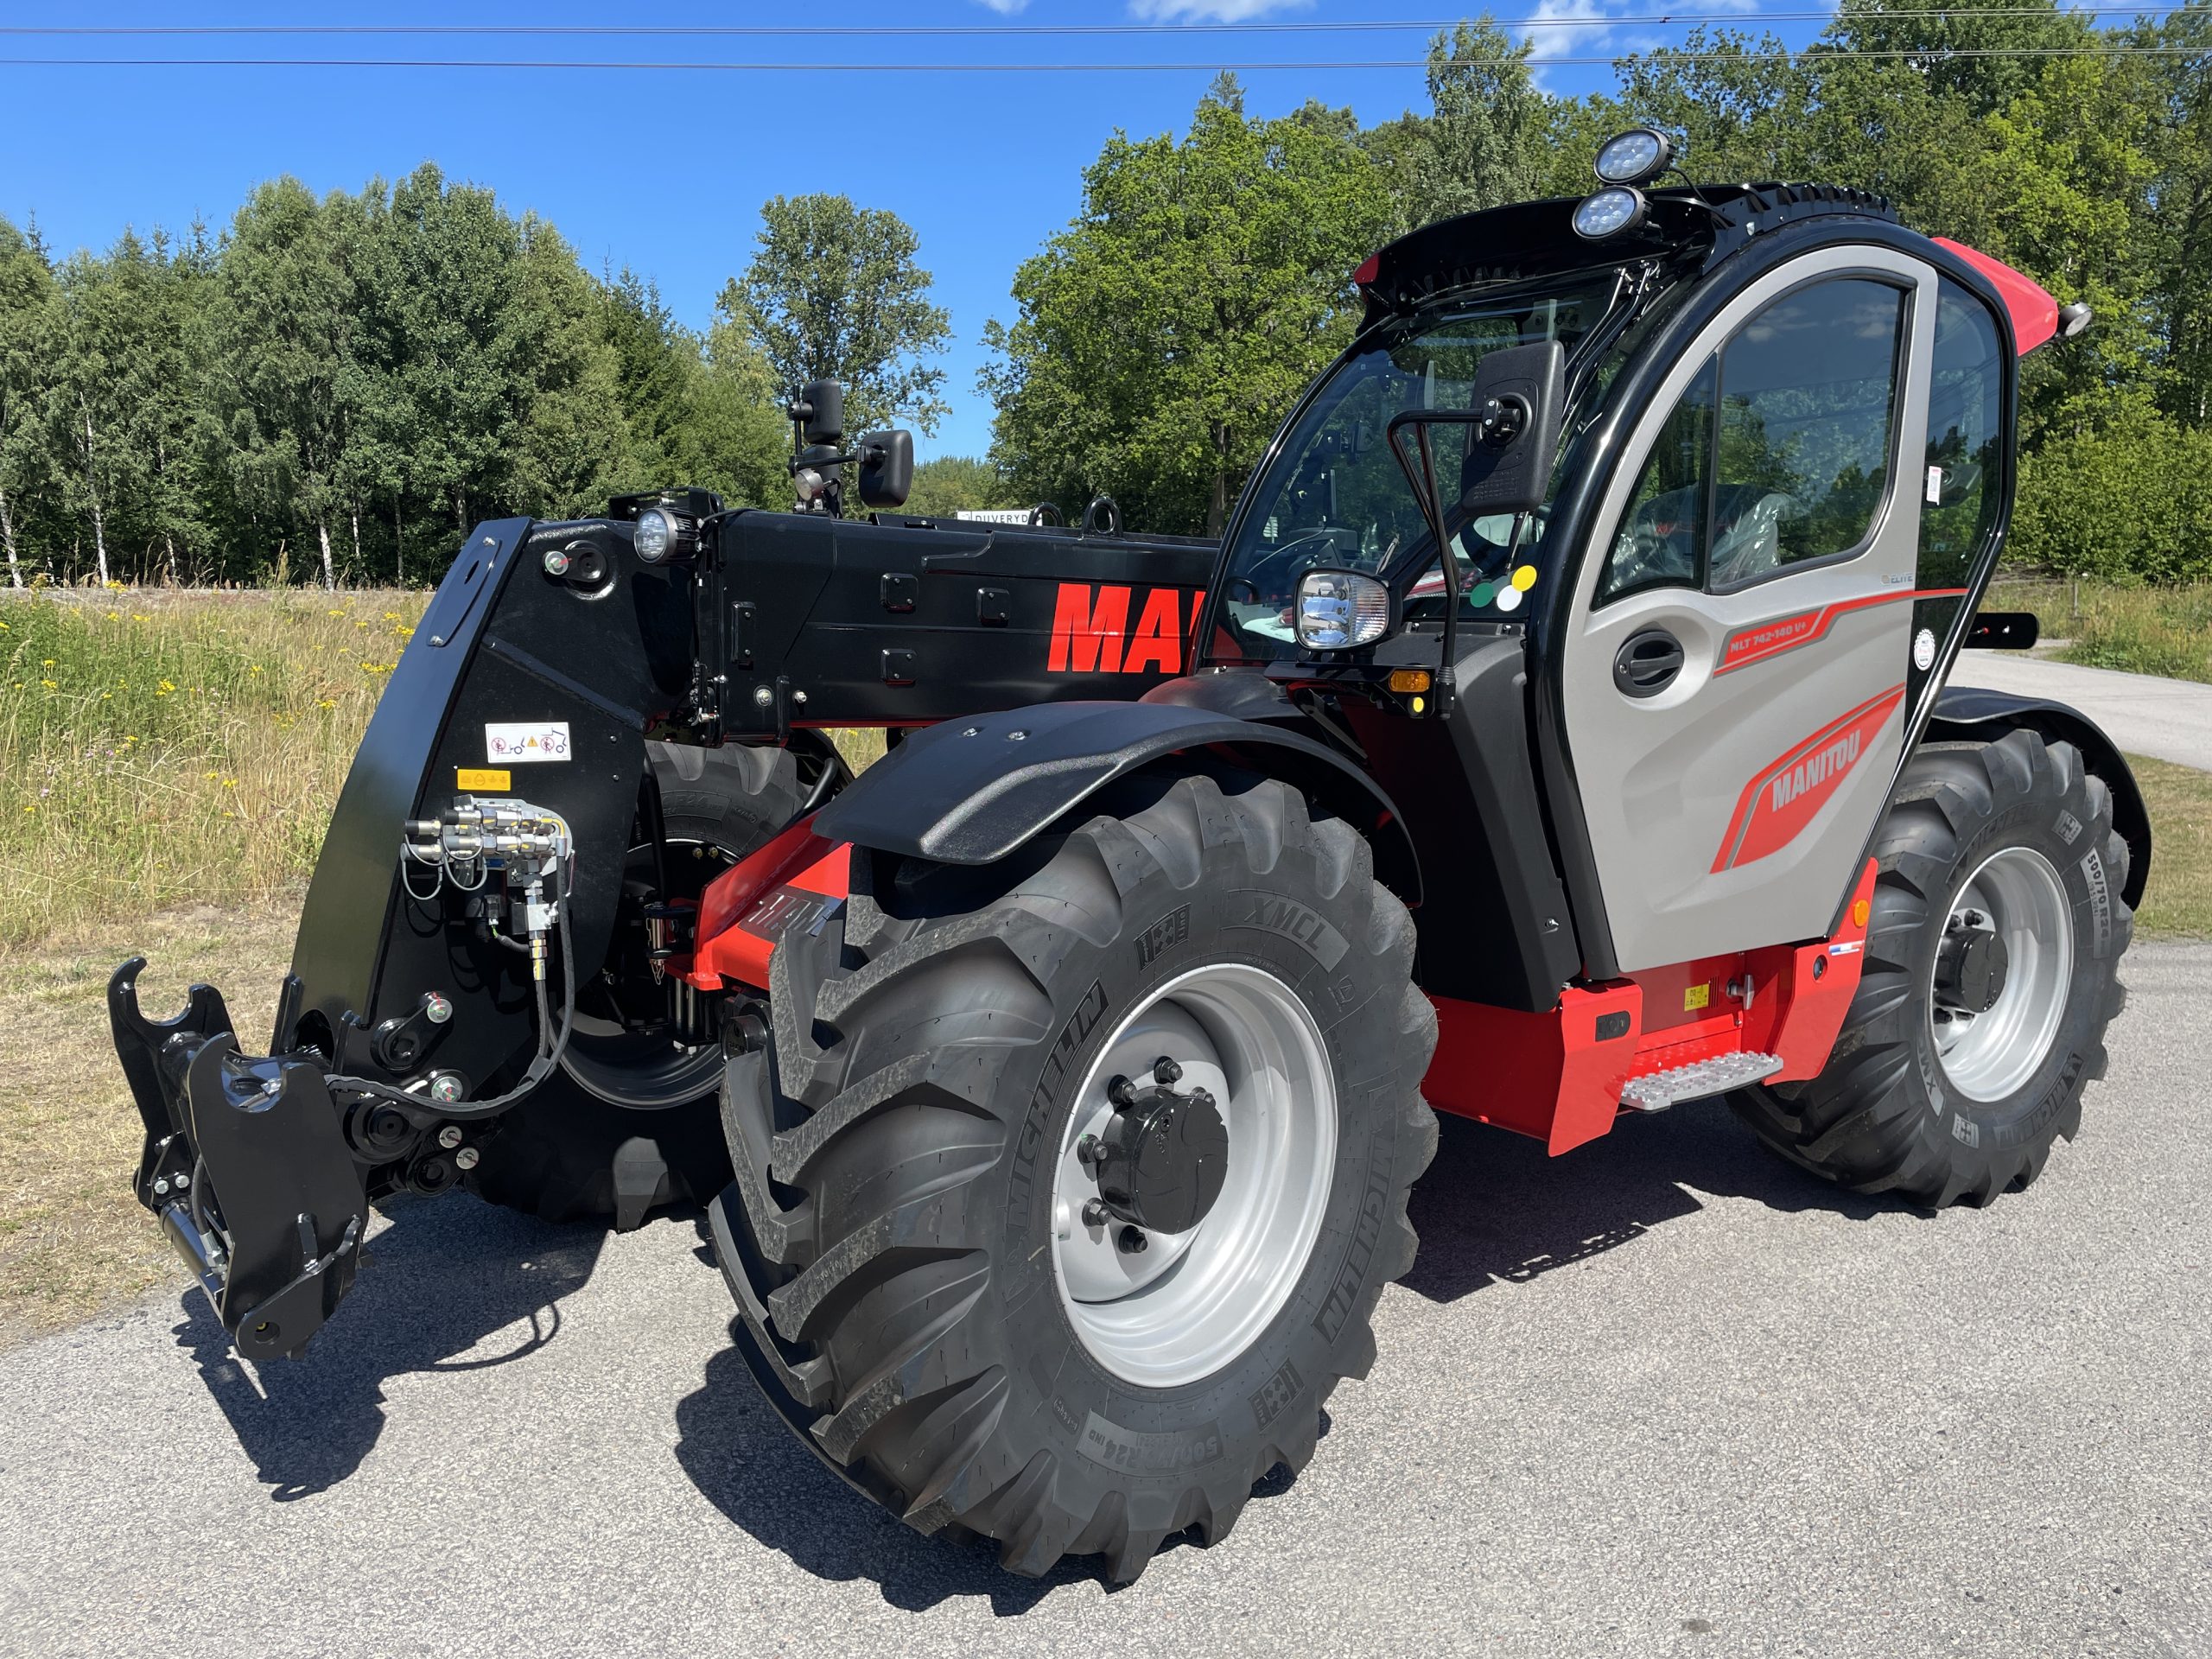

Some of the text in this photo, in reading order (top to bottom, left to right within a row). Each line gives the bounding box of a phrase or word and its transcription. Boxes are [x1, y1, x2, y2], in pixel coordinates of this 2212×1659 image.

[1731, 639, 1751, 653] MLT
[1772, 729, 1862, 812] MANITOU
[2087, 854, 2107, 905] 500/70
[1244, 897, 1327, 951] XMCL
[1007, 983, 1103, 1226] MICHELIN
[1320, 1134, 1394, 1340] MICHELIN
[1087, 1428, 1106, 1446] IND
